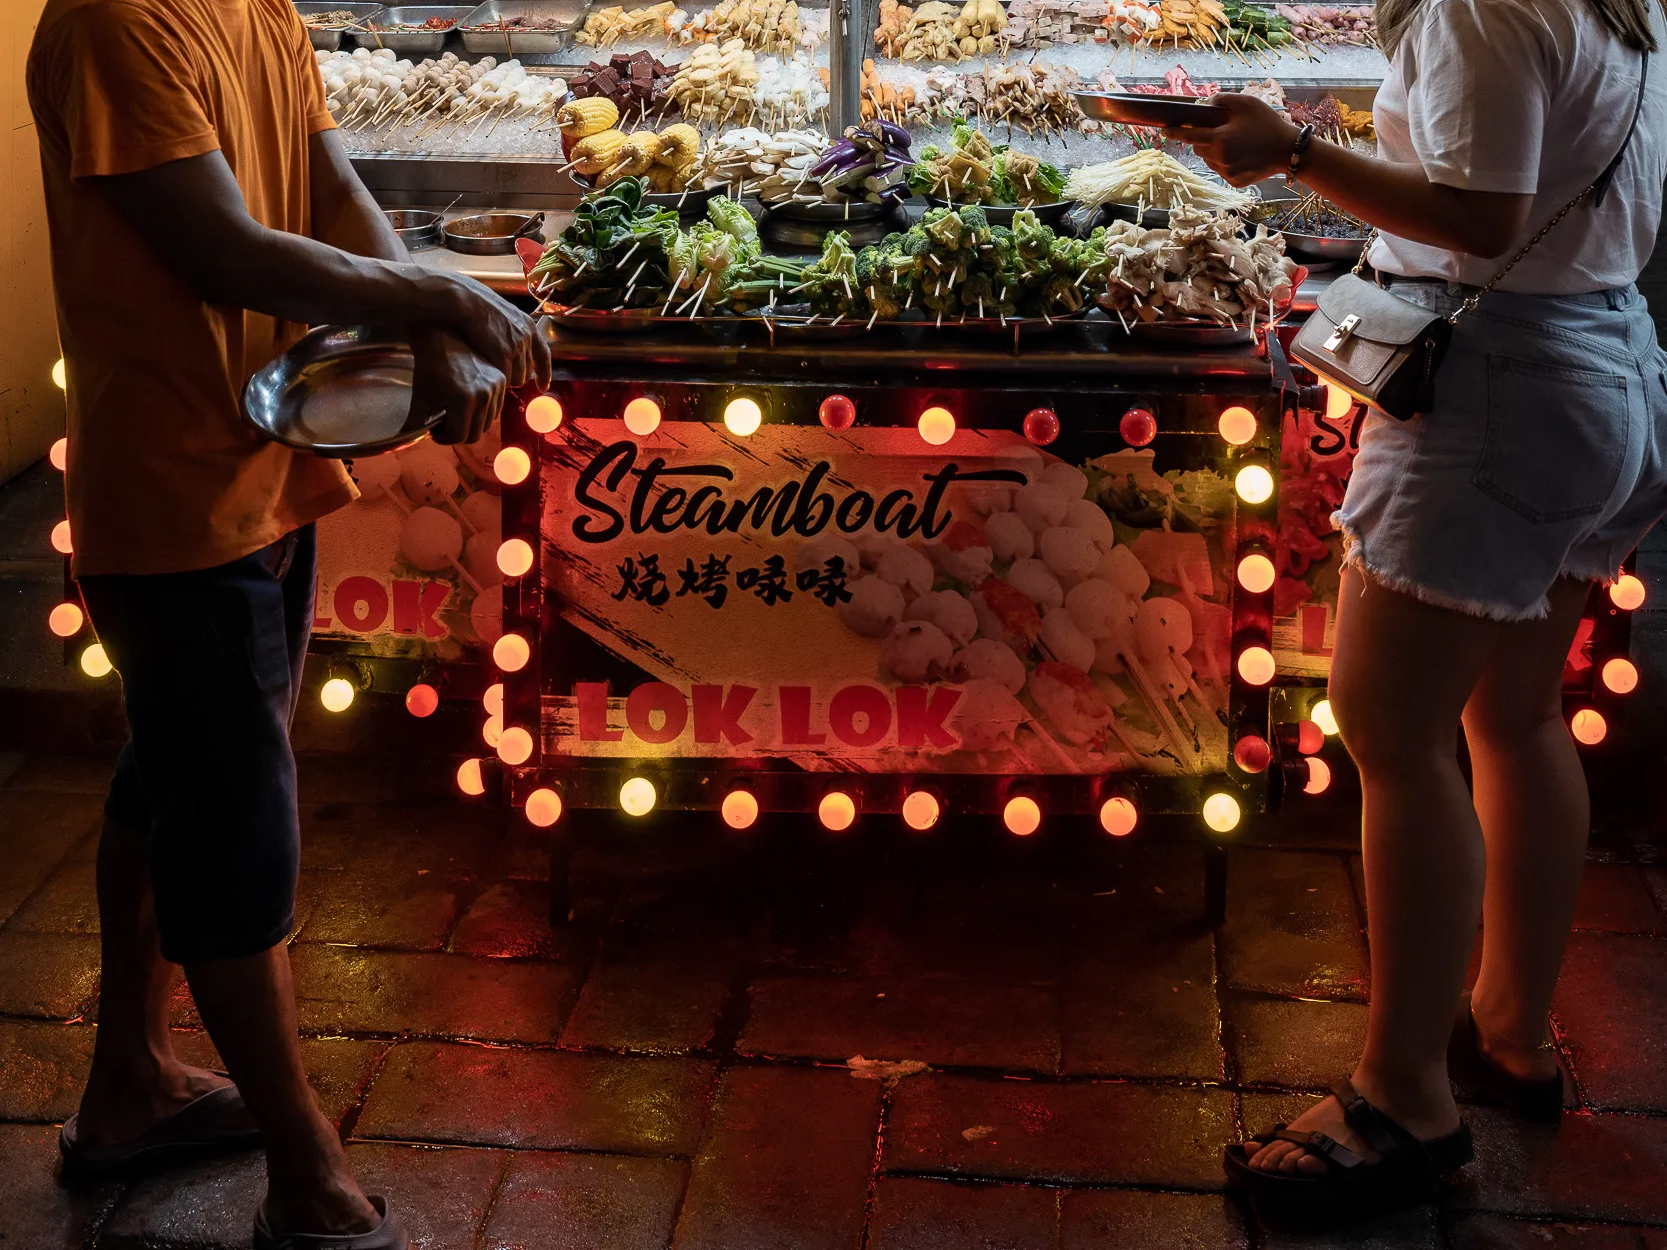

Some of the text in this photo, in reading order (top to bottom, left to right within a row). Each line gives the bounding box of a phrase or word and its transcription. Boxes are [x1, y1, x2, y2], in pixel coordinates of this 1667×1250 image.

[572, 440, 1027, 544] Steamboat
[576, 681, 963, 749] LOK LOK
